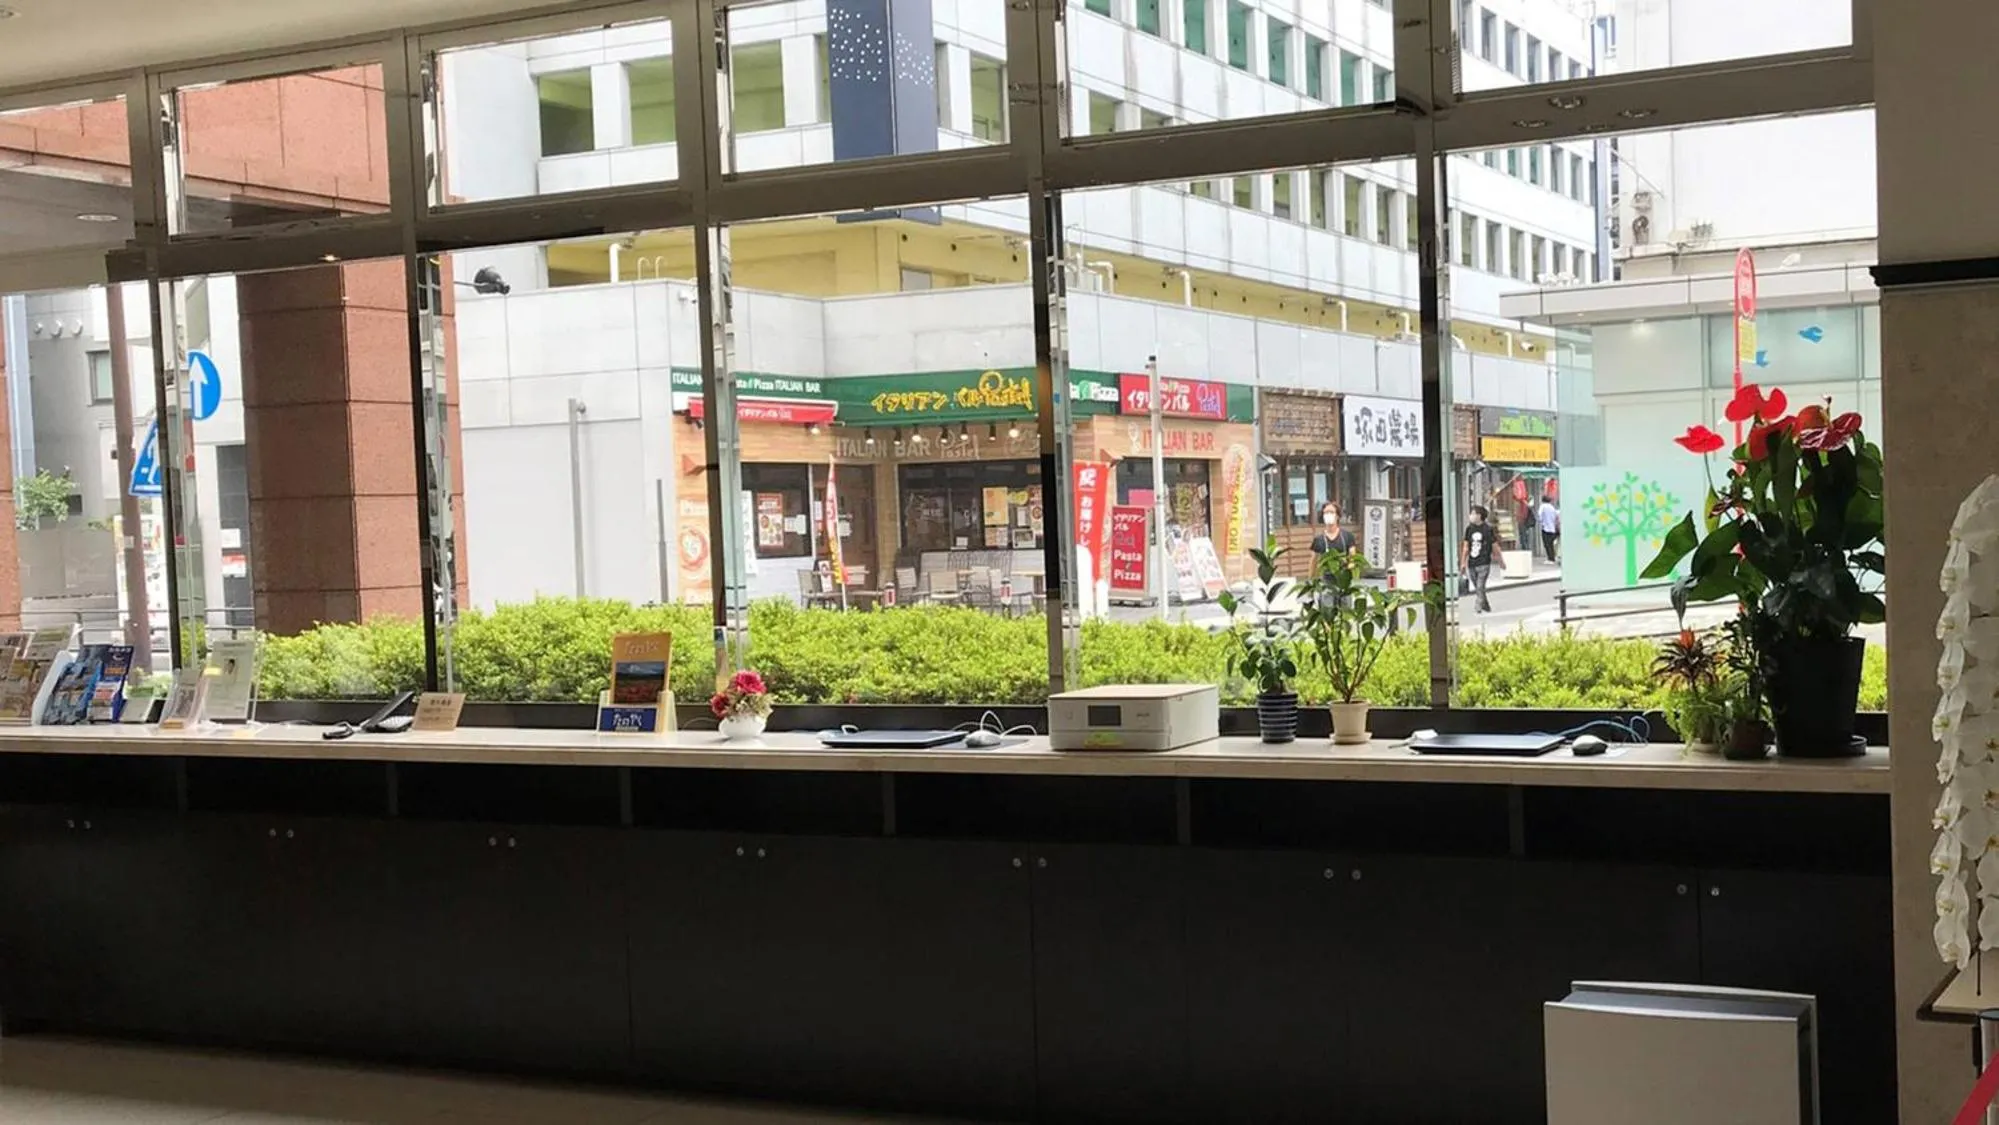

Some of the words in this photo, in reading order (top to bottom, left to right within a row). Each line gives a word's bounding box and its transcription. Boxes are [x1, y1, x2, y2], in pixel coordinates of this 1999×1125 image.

[871, 391, 948, 413] イタリアン
[835, 436, 887, 458] ITALIAN
[894, 439, 931, 457] BAR
[1193, 431, 1214, 451] BAR
[1113, 549, 1143, 562] Pasta
[1113, 568, 1142, 581] Pizza
